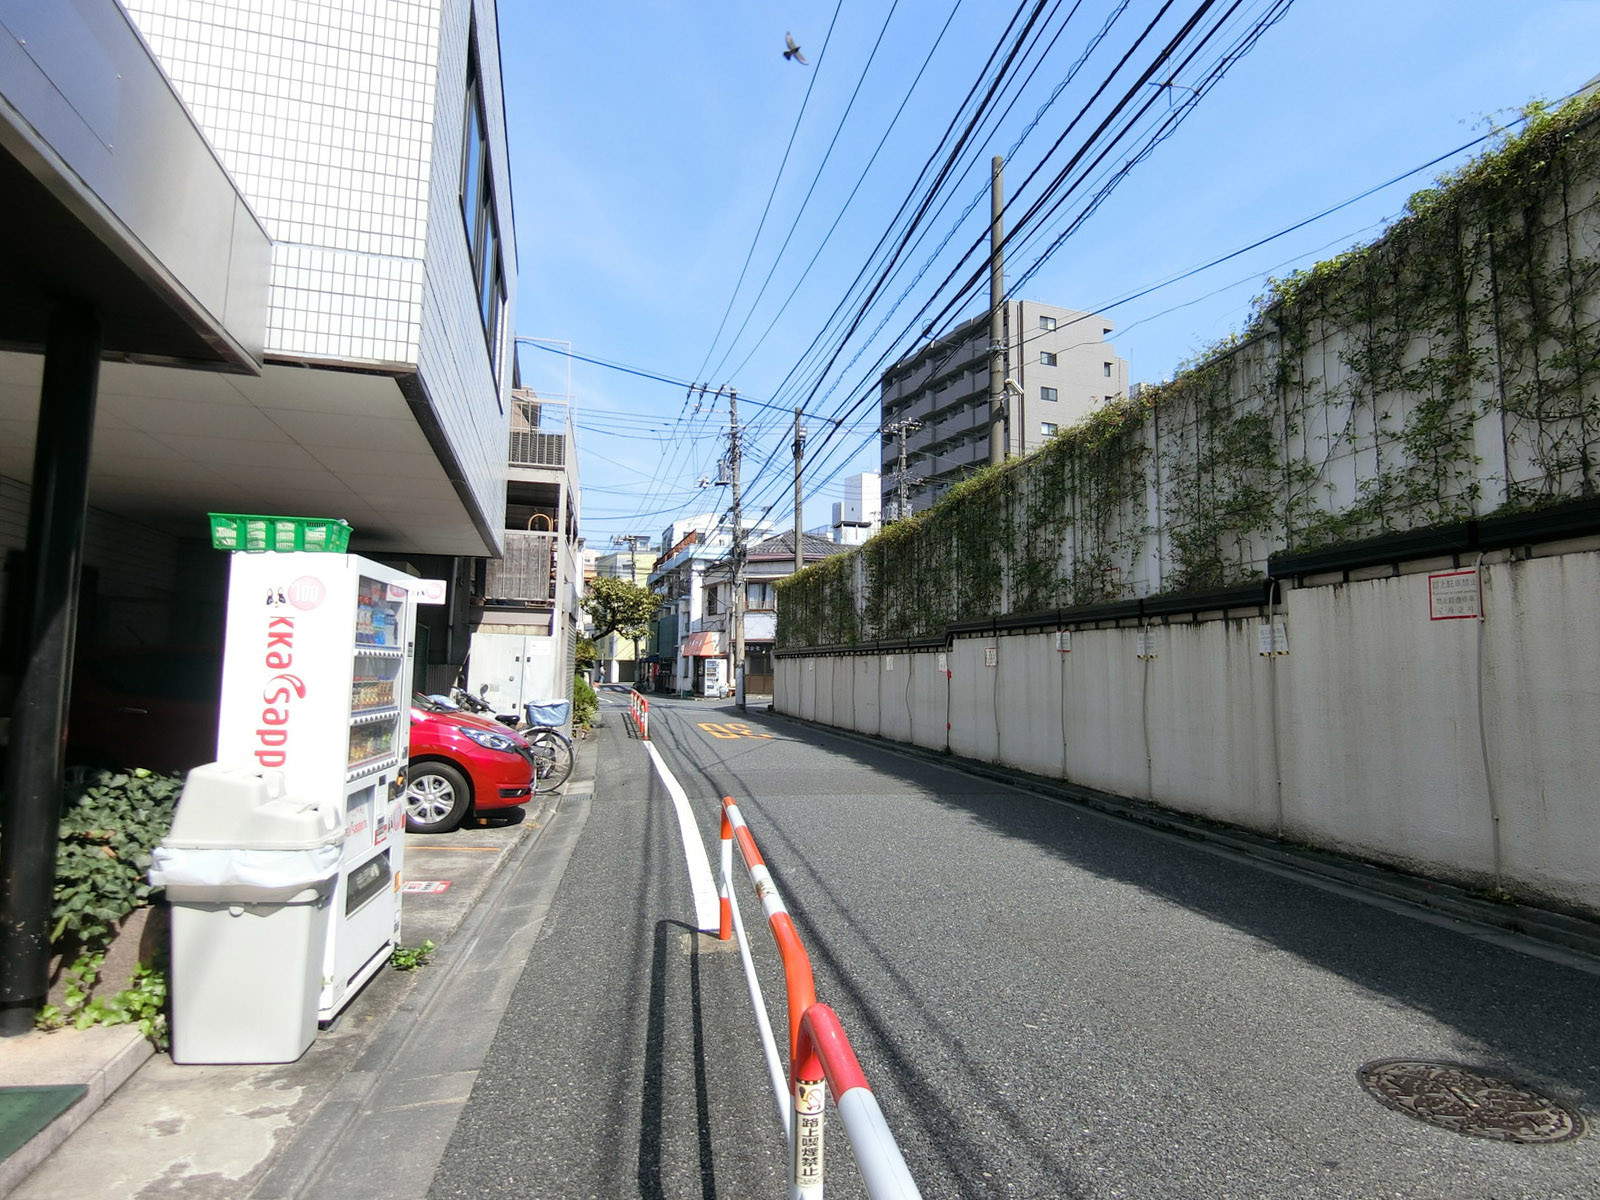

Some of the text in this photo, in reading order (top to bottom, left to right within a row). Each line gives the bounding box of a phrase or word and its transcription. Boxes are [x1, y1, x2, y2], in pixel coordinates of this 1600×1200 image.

[801, 1117, 820, 1177] 路上喫煙禁止
